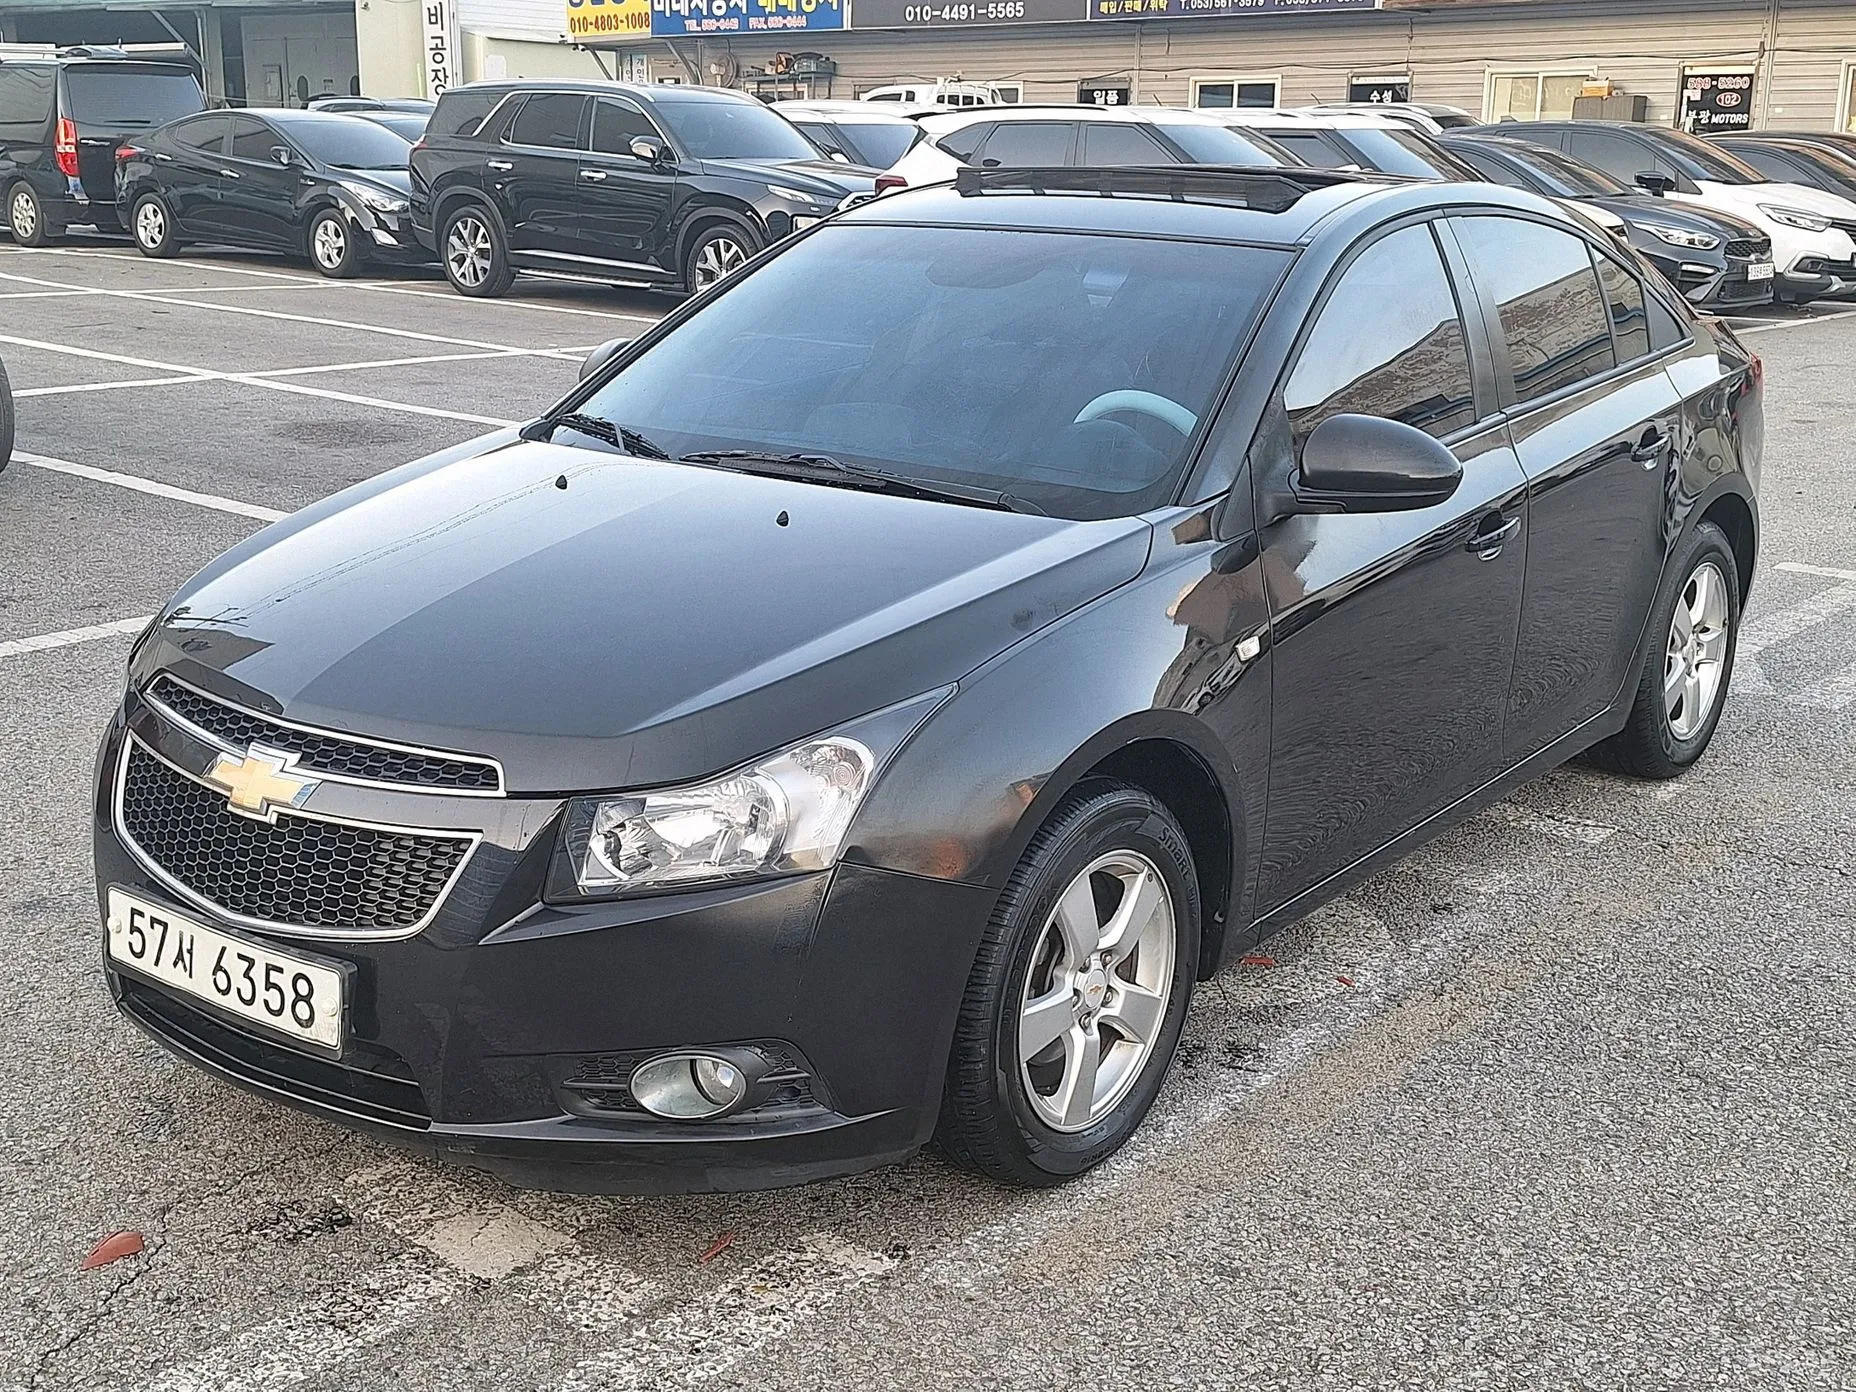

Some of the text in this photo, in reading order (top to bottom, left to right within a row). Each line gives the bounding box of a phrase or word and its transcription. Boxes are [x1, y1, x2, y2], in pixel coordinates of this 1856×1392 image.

[905, 2, 1025, 21] 010-4491-5565
[570, 12, 650, 33] 010-4803-1008
[1720, 94, 1738, 106] 102
[1711, 113, 1748, 124] MOTORS
[128, 907, 315, 1029] 57서 6358
